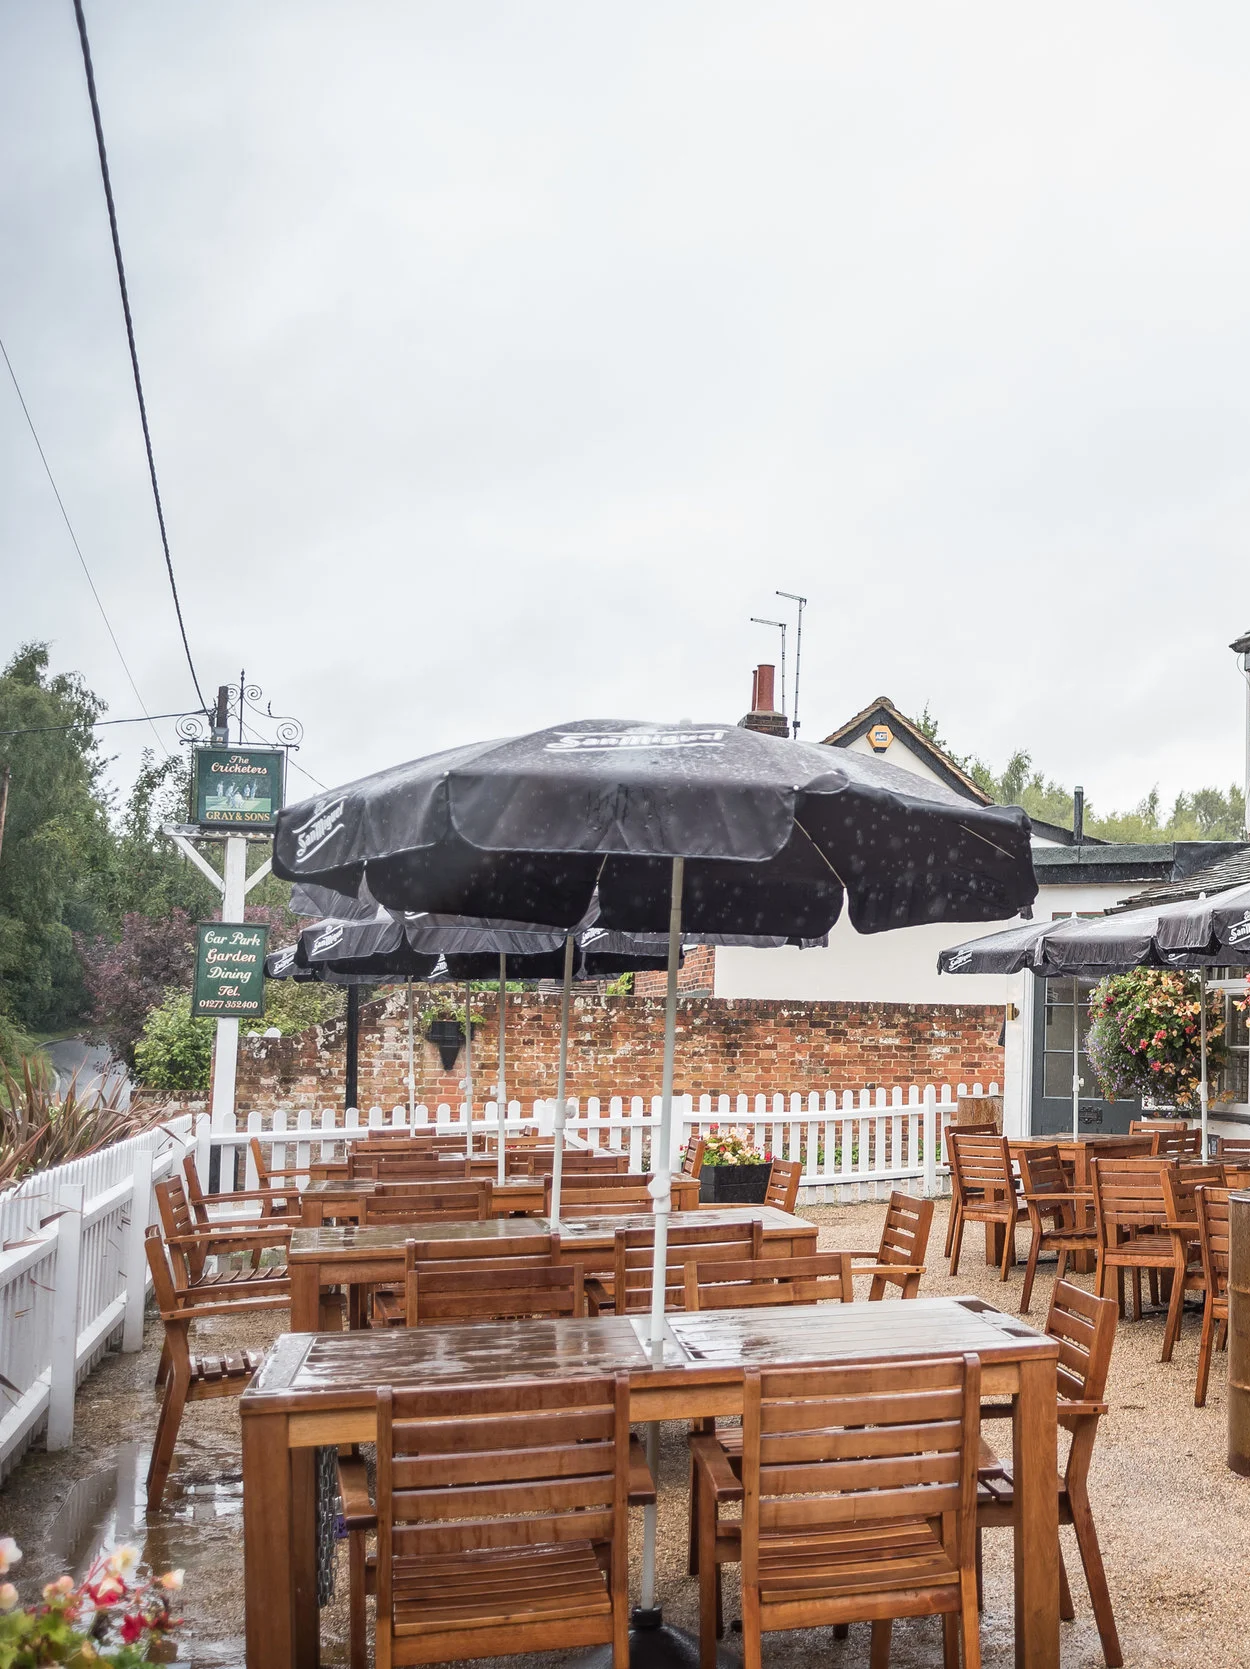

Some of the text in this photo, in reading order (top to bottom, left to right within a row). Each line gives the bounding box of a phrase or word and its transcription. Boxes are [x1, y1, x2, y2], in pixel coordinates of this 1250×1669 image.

[229, 755, 249, 764] The
[211, 762, 268, 775] Cricketers
[206, 811, 270, 822] GRAY & SONS
[204, 931, 261, 946] Car Park
[205, 948, 257, 963] Garden
[207, 966, 252, 983] Dining
[218, 985, 240, 996] Tel.
[199, 999, 259, 1009] 01277 352400
